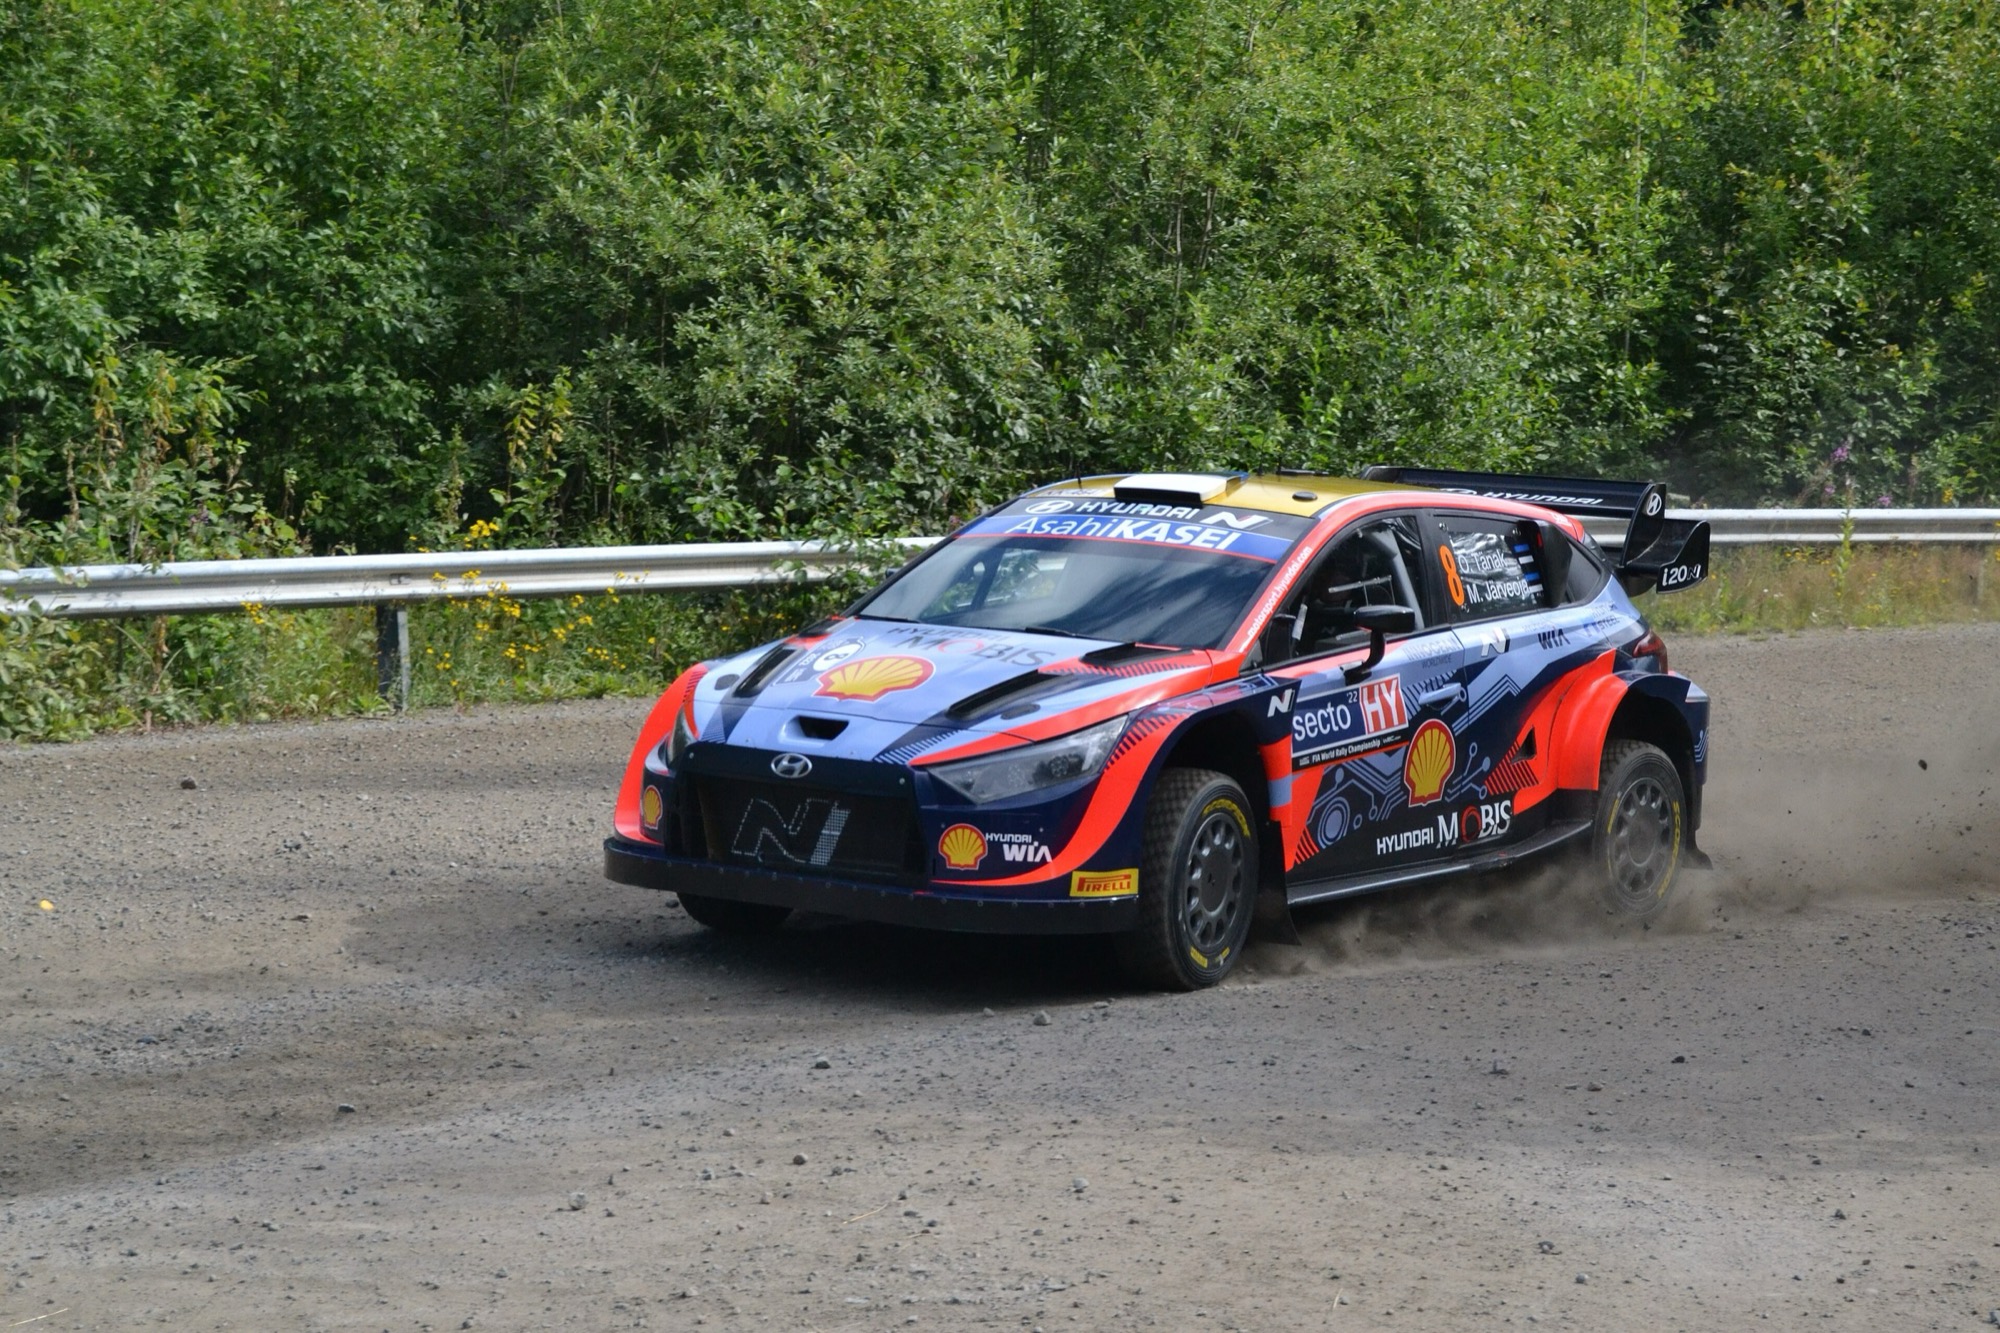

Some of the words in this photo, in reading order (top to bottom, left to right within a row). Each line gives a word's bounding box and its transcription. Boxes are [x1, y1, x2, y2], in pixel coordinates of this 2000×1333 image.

[1077, 501, 1201, 519] HYUNDAI
[1483, 491, 1603, 505] HYUNDAI
[1005, 517, 1242, 550] AsahiKASEI
[1458, 553, 1473, 573] O.
[1471, 548, 1507, 572] Tänak
[1439, 544, 1465, 606] 8
[1466, 583, 1484, 604] M.
[1485, 578, 1529, 600] Järveoja
[1597, 615, 1621, 631] STEEL
[894, 635, 1056, 666] MOBIS
[1538, 627, 1571, 650] WIA
[1267, 687, 1295, 718] N
[1292, 702, 1352, 742] secto
[1346, 690, 1358, 704] '22
[1362, 680, 1401, 734] HY
[1321, 750, 1335, 761] World
[1335, 747, 1348, 758] Rally
[1348, 738, 1381, 754] Championship
[985, 832, 1032, 843] HYUNDAI
[1376, 826, 1434, 855] HYUNDAI
[1436, 800, 1513, 849] MOBIS
[1002, 841, 1053, 863] WIA
[1077, 873, 1132, 892] PIRELLI
